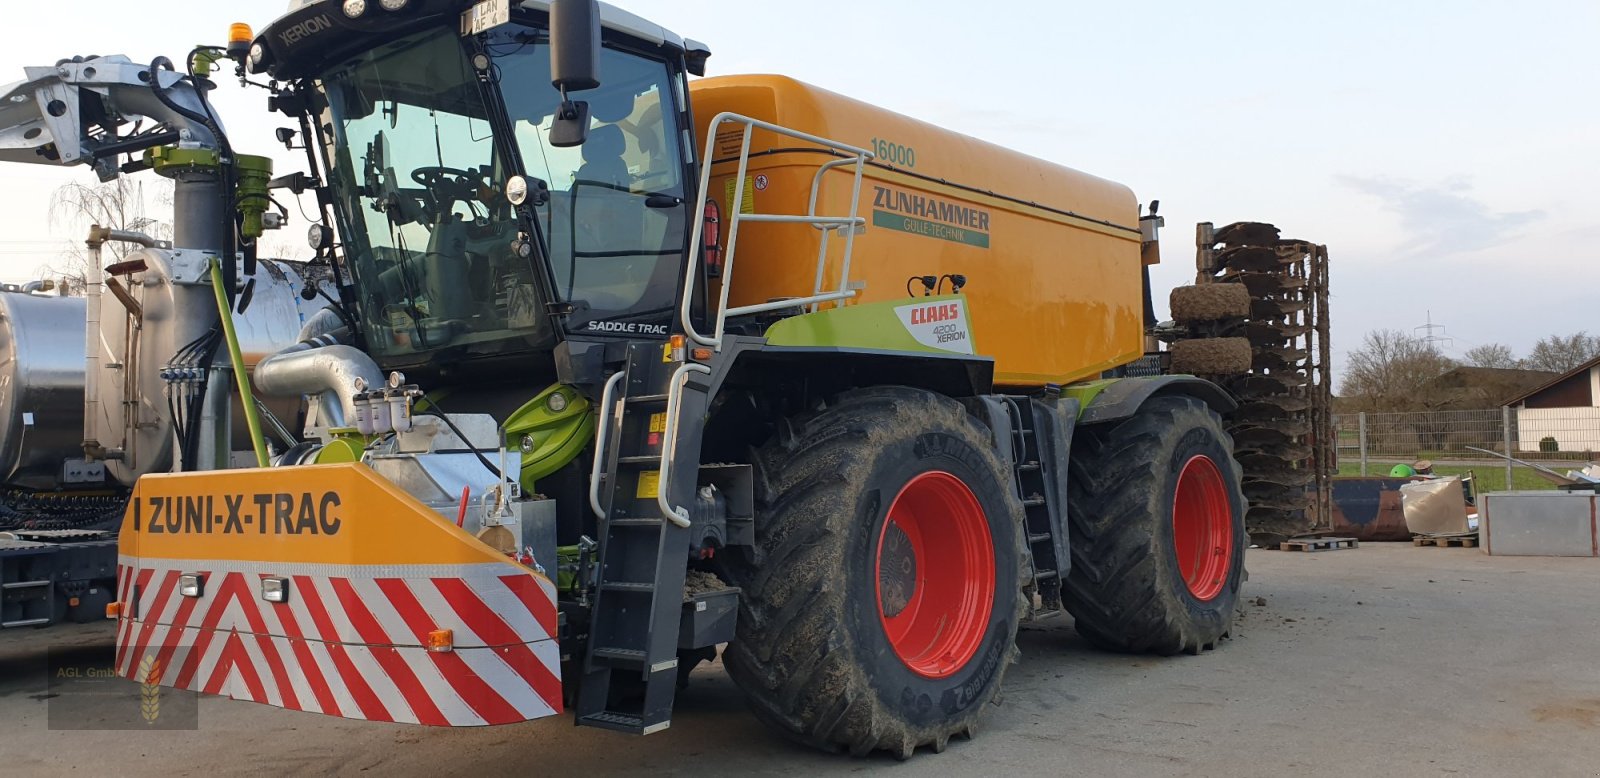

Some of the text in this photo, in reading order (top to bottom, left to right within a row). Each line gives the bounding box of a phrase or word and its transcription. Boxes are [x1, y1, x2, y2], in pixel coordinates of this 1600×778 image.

[279, 14, 332, 47] XERION
[871, 137, 915, 168] 16000
[873, 185, 989, 230] ZUNHAMMER
[911, 303, 958, 325] CLAAS
[588, 321, 668, 335] SADDLE TRAC
[933, 323, 957, 335] 4200
[937, 331, 966, 344] XERION
[148, 491, 341, 535] ZUNI-X-TRAC
